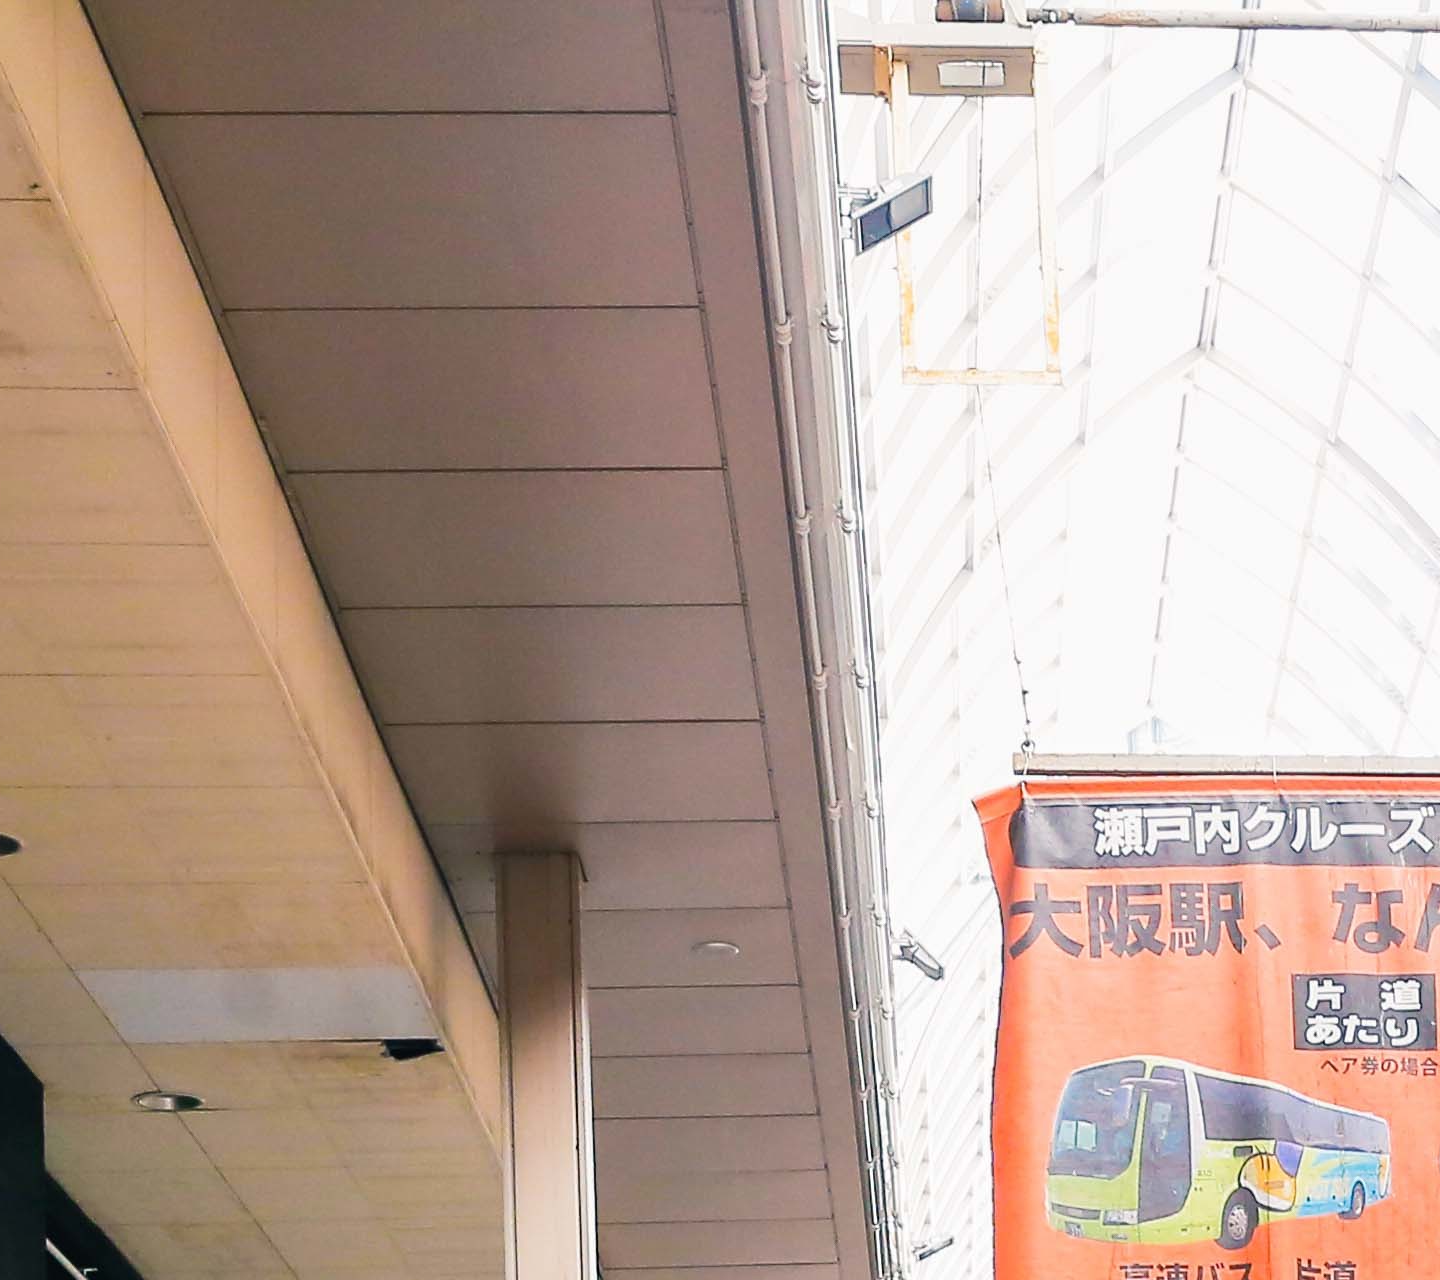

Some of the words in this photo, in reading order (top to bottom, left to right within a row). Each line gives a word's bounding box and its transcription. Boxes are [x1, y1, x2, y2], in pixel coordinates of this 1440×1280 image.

[1305, 979, 1424, 1015] 片道
[1305, 1014, 1421, 1048] あたり
